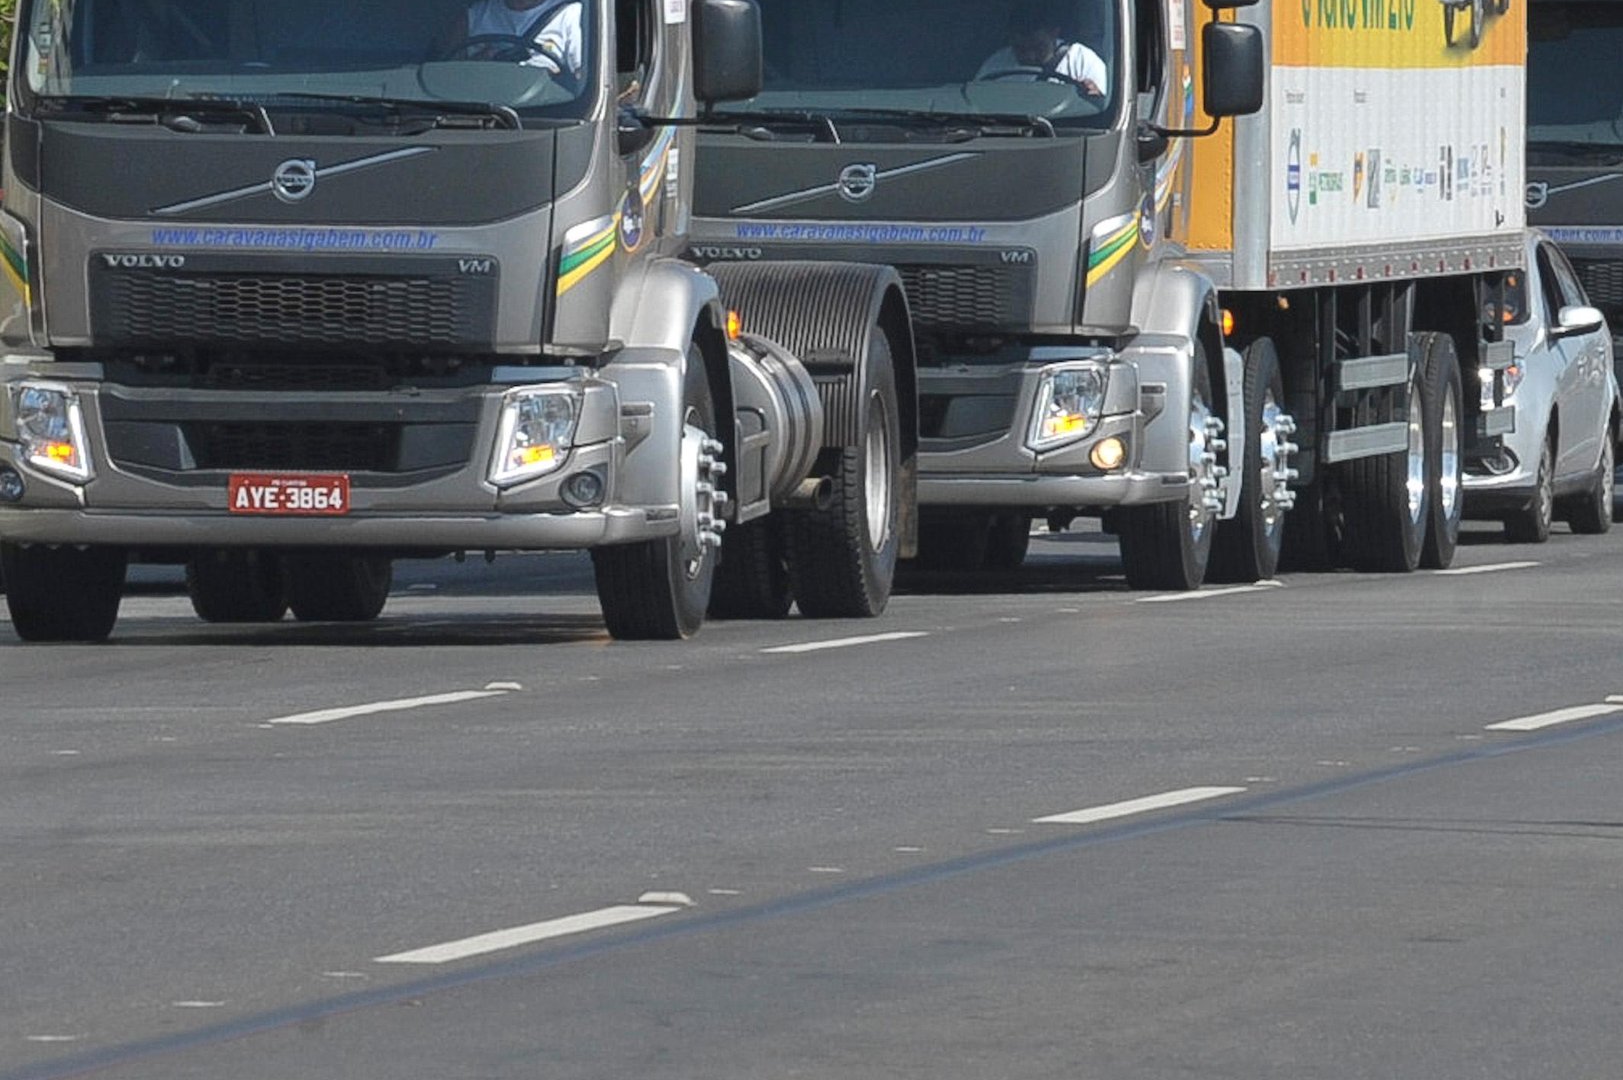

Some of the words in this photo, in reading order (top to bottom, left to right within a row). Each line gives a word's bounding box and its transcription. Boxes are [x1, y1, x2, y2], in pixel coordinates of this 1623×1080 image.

[152, 228, 438, 252] www.caravanasigabem.com.br
[692, 246, 762, 259] VOLVO
[1000, 251, 1029, 263] VM
[103, 255, 185, 268] VOLVO
[458, 259, 491, 274] VM
